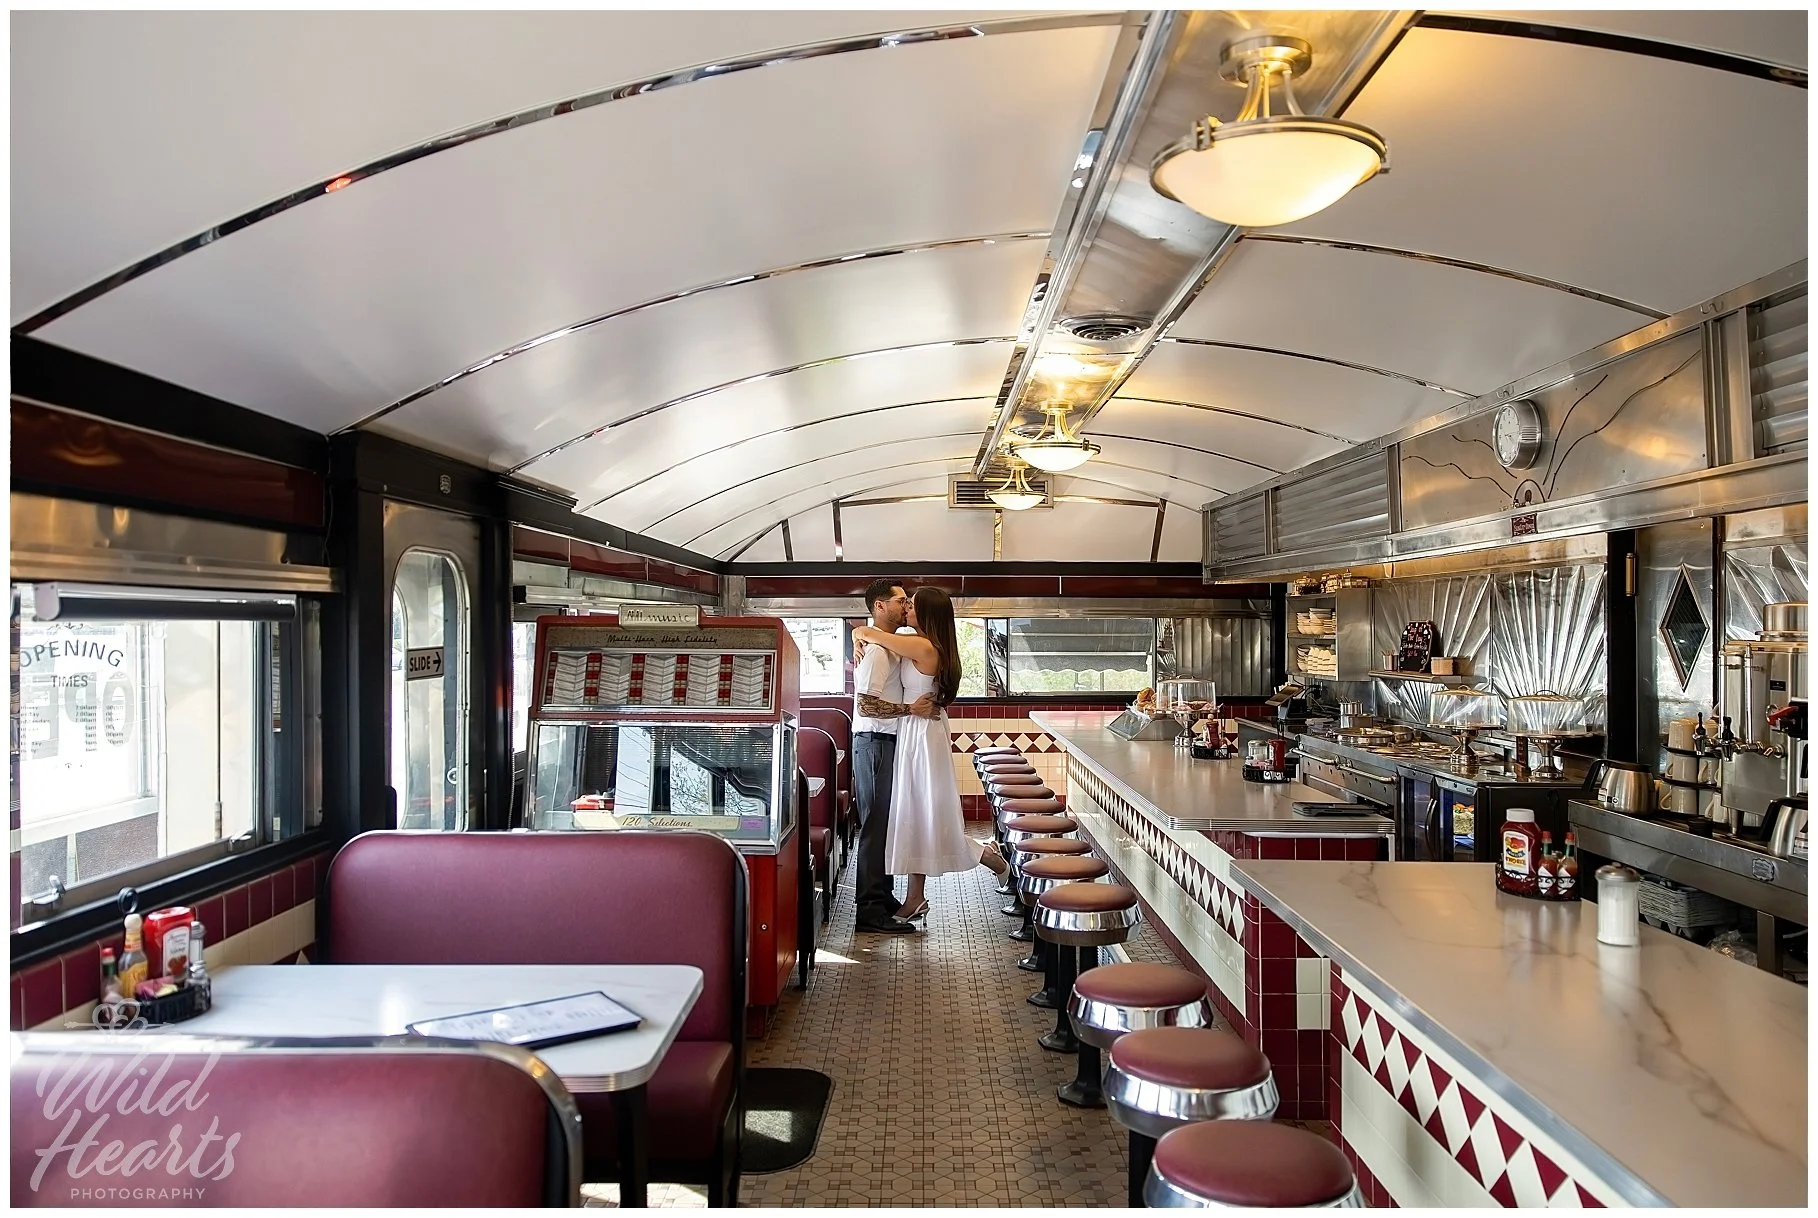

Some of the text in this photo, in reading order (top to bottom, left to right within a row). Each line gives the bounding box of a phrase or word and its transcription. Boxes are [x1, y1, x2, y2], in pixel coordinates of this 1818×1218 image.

[644, 613, 693, 622] music
[20, 639, 124, 667] OPENING
[409, 656, 431, 672] SLIDE
[50, 675, 88, 688] TIMES
[622, 816, 693, 828] 120 Selections
